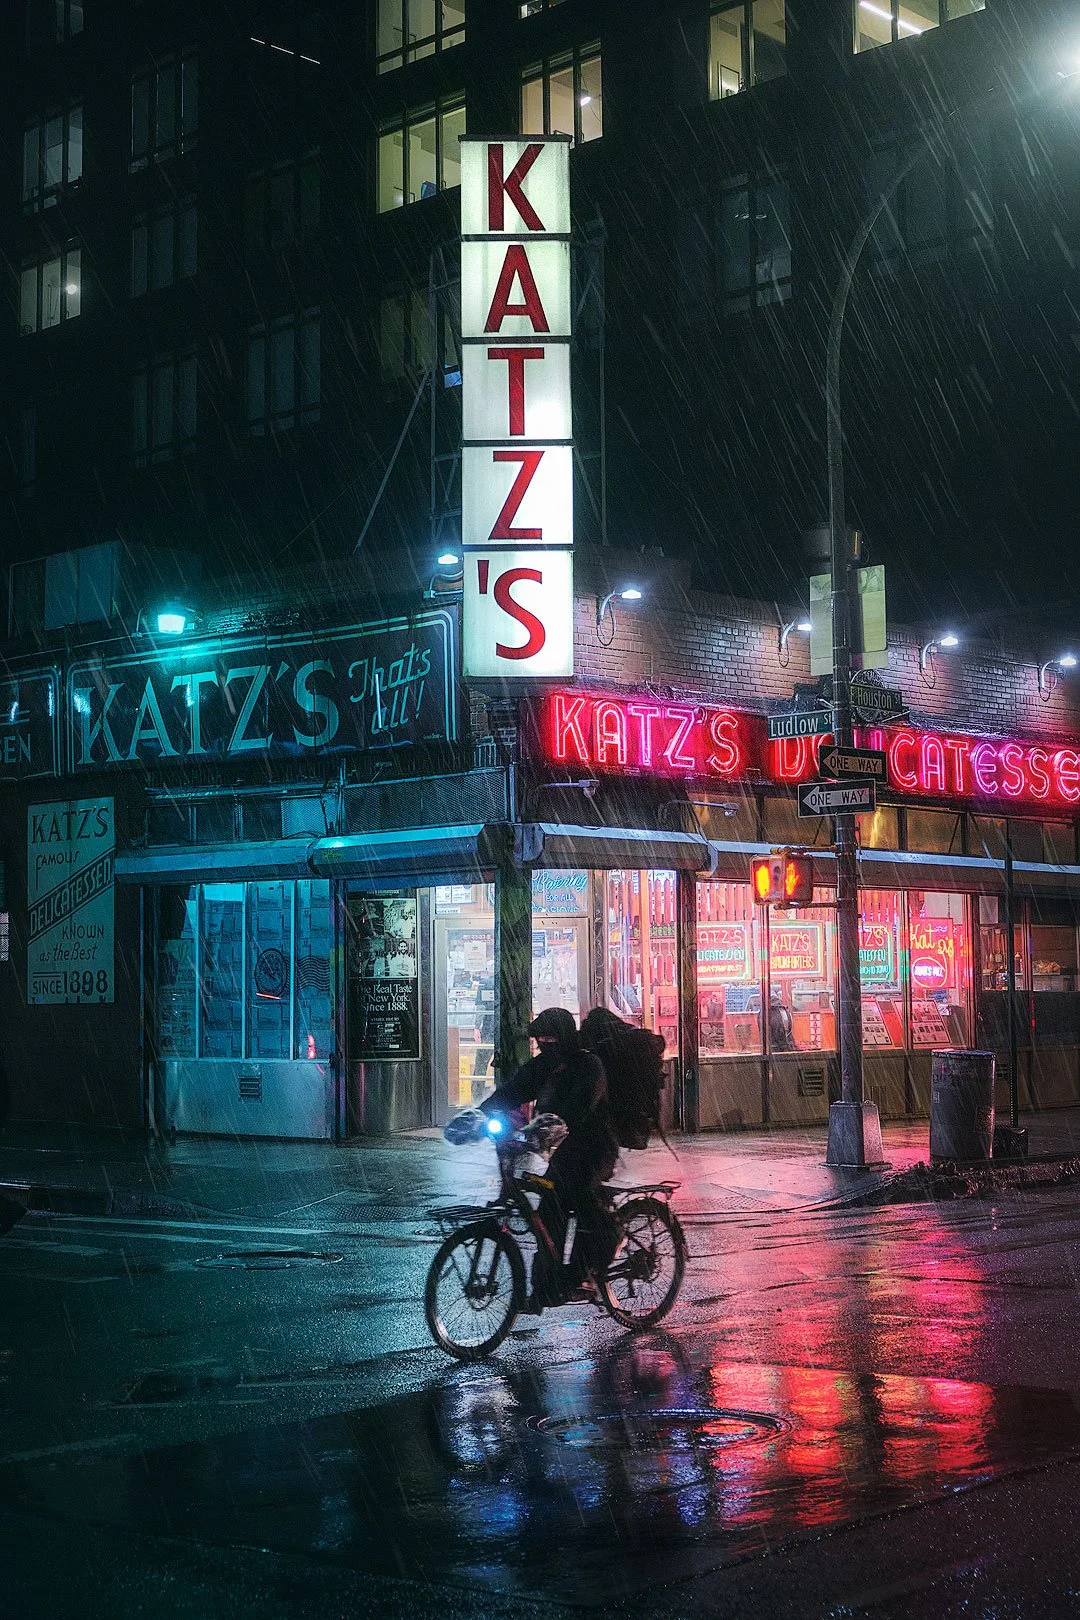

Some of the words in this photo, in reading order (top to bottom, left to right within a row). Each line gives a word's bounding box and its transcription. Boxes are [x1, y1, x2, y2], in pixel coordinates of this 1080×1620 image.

[476, 142, 551, 661] KATZ'S
[348, 642, 431, 703] That's
[857, 686, 892, 709] Houston
[77, 659, 341, 765] KATZ'S
[770, 715, 819, 737] Ludlow
[823, 712, 832, 725] St
[555, 696, 740, 774] KATZ'S
[829, 756, 849, 770] ONE
[857, 758, 879, 773] WAY
[810, 793, 832, 806] ONE
[841, 789, 865, 803] WAY
[31, 807, 109, 844] KATZ'S
[699, 930, 742, 944] ATZS
[771, 932, 809, 952] KATZ'S
[39, 951, 51, 962] as
[53, 943, 70, 961] the
[70, 942, 98, 961] Best
[32, 980, 62, 995] SINCE
[373, 984, 392, 994] Real
[393, 983, 413, 993] Taste
[360, 1002, 385, 1012] Since
[368, 993, 389, 1003] New
